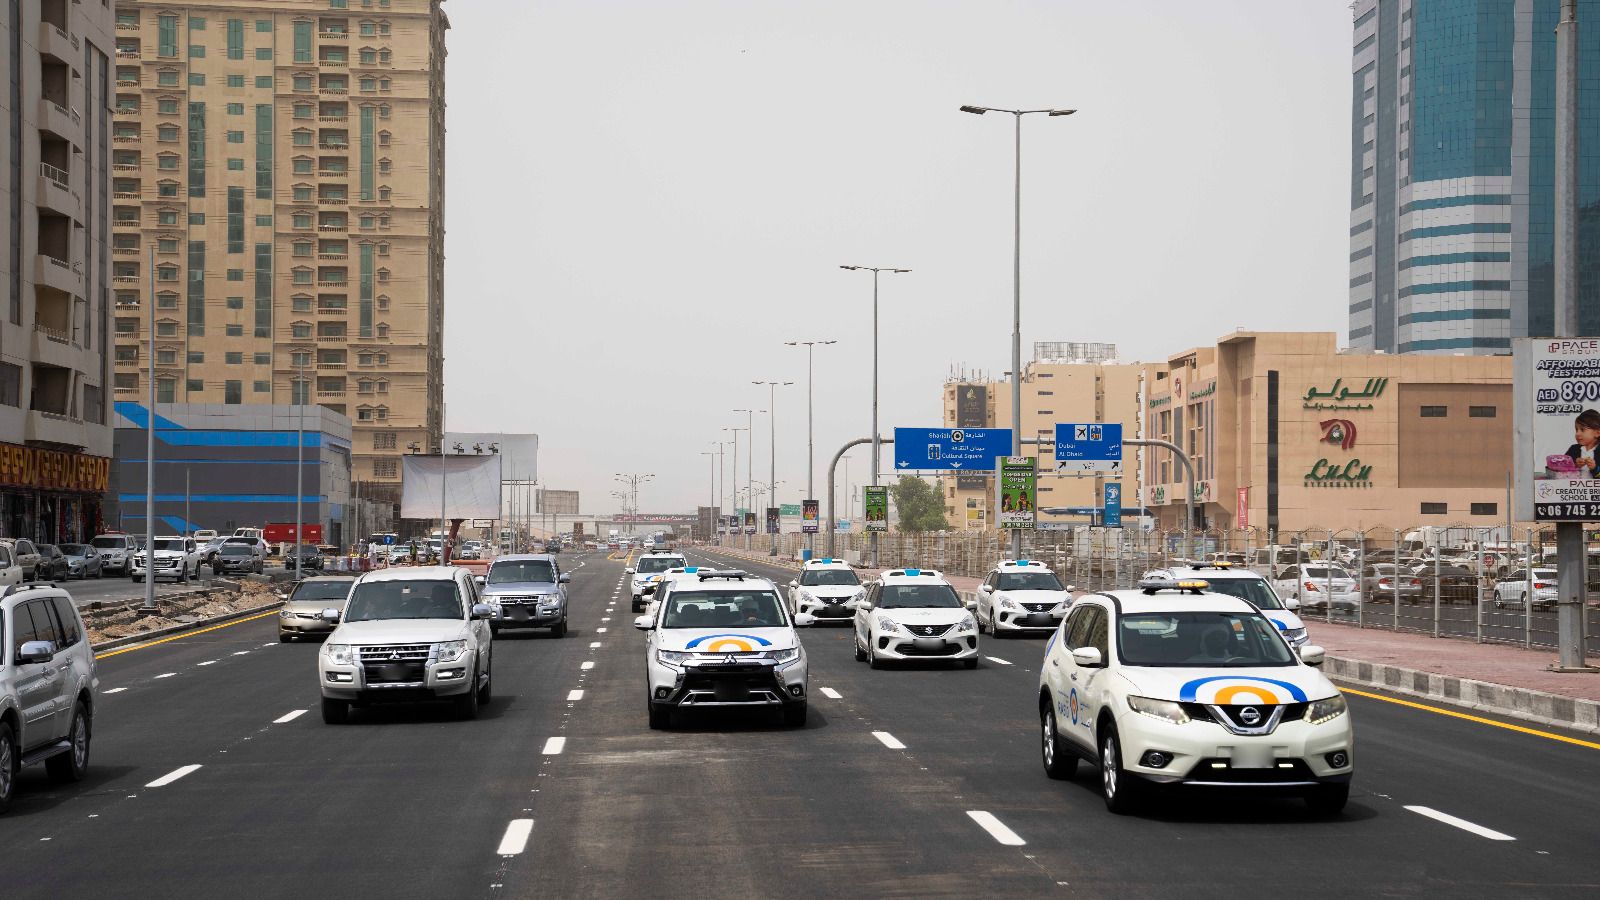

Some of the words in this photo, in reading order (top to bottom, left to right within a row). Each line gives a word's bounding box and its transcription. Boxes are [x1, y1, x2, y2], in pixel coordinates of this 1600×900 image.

[1562, 341, 1598, 349] PACE
[1548, 369, 1571, 377] FEES
[1573, 368, 1600, 377] FROM
[1303, 378, 1388, 401] اللولو
[1537, 389, 1558, 401] AED
[1561, 381, 1600, 401] 890
[1537, 404, 1556, 413] PER
[1557, 404, 1583, 413] YEAR
[1304, 458, 1373, 481] LuLu
[1569, 480, 1600, 488] PACE
[1547, 505, 1562, 516] 06
[1565, 504, 1586, 516] 745
